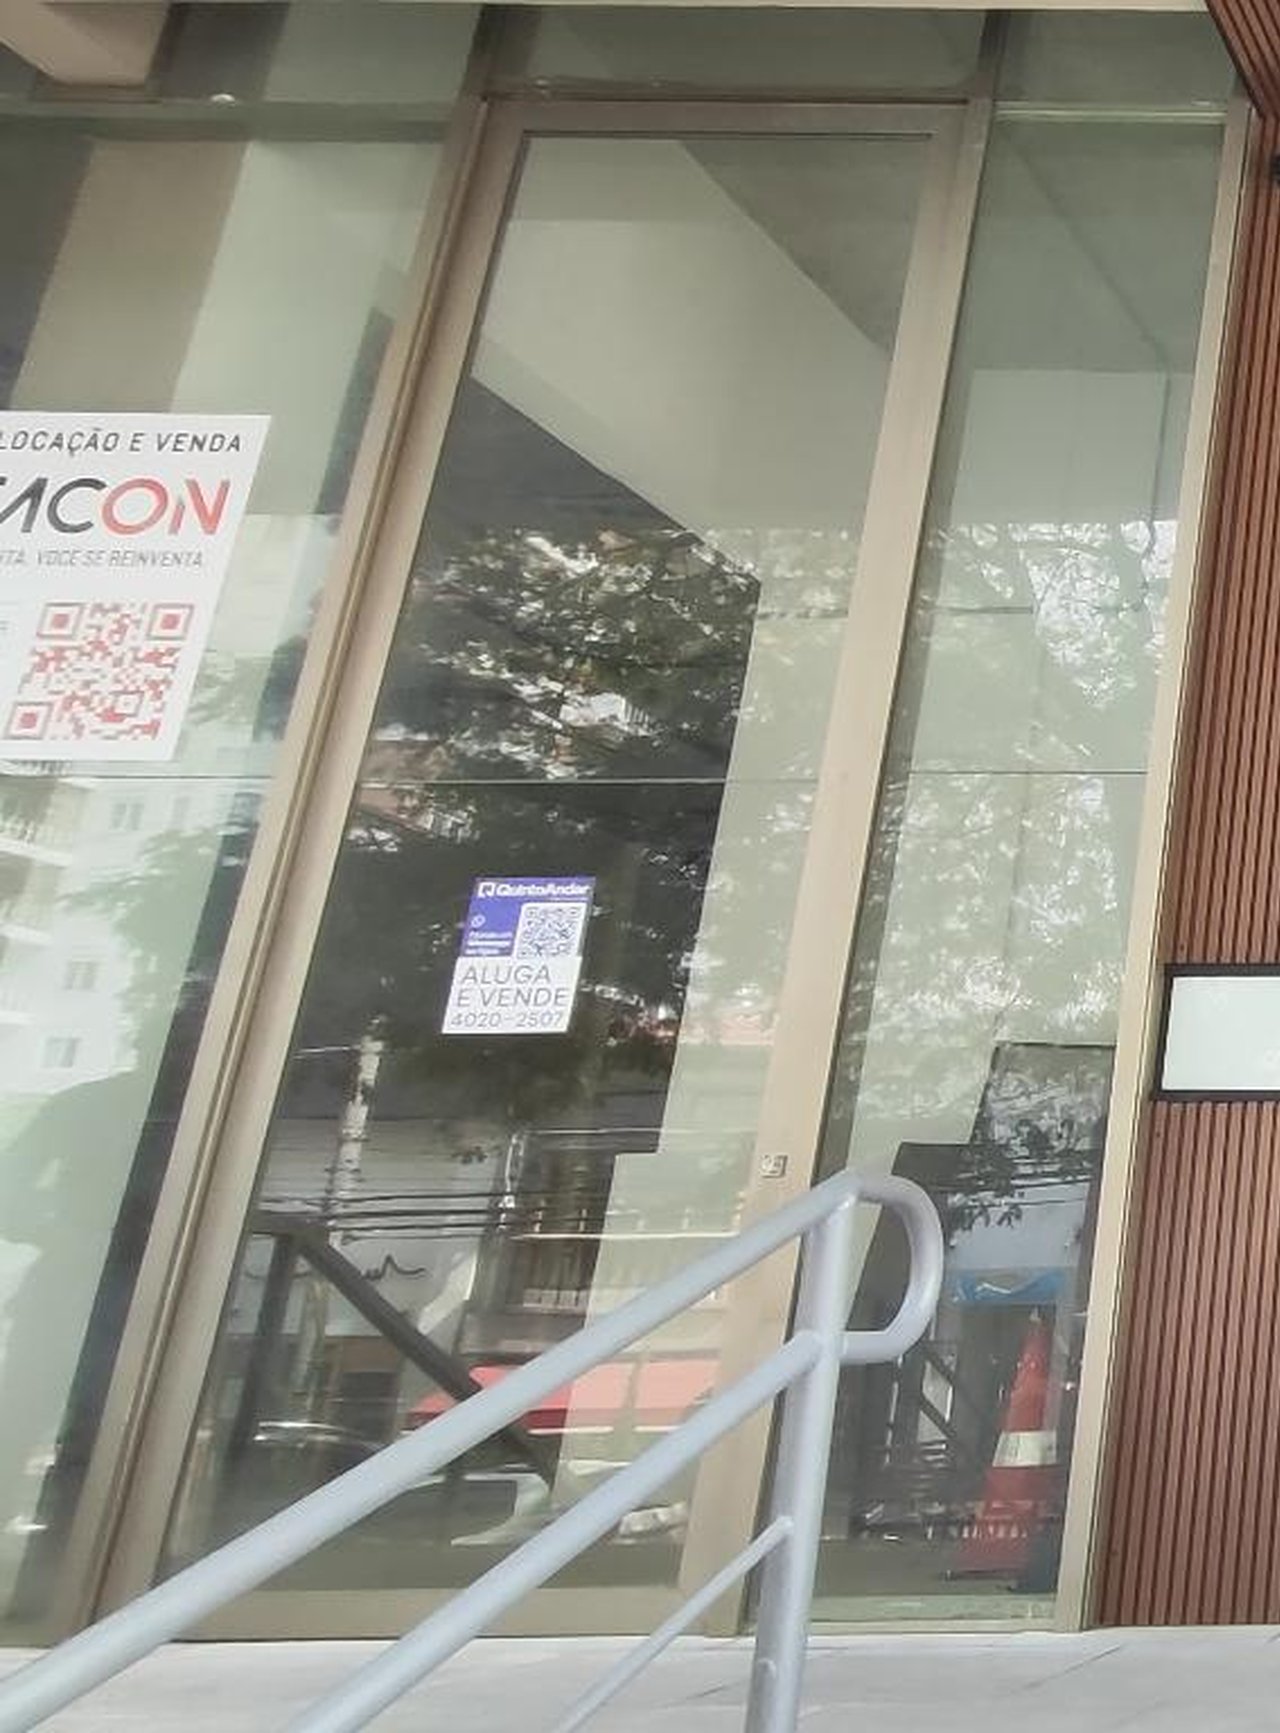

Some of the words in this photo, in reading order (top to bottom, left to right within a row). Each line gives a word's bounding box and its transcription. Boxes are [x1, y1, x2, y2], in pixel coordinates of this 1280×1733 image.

[129, 432, 145, 452] E
[157, 432, 241, 452] VENDA
[0, 476, 231, 536] ACON
[461, 965, 551, 985] ALUGA
[457, 987, 471, 1007] E
[480, 987, 569, 1007] VENDE
